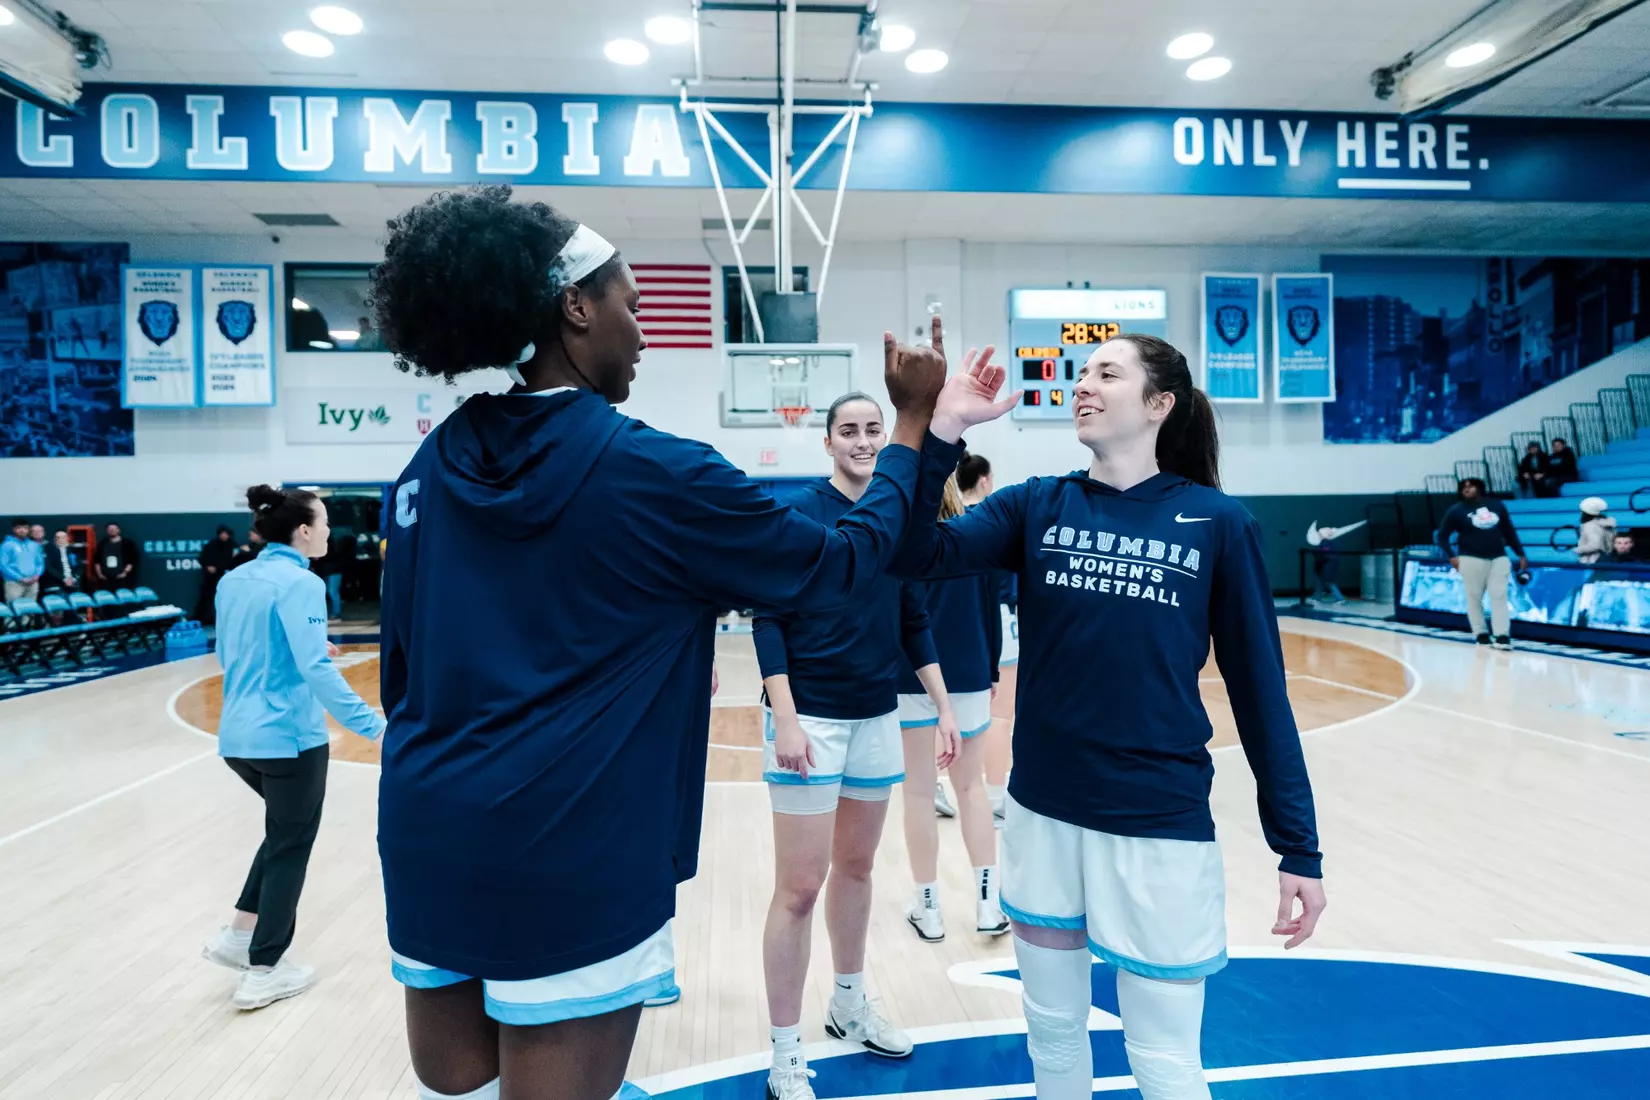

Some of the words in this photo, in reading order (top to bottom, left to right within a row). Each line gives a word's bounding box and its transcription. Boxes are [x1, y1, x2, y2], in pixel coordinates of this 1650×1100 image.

[17, 93, 690, 176] COLUMBIA
[1173, 117, 1308, 166] ONLY
[1337, 121, 1489, 170] HERE.
[1114, 300, 1156, 310] LIONS
[1042, 360, 1056, 381] 0
[1051, 390, 1063, 406] 4
[318, 402, 364, 431] Ivy
[396, 478, 420, 528] C
[1042, 525, 1201, 571] COLUMBIA
[1069, 556, 1164, 583] WOMEN'S
[1045, 570, 1180, 607] BASKETBALL
